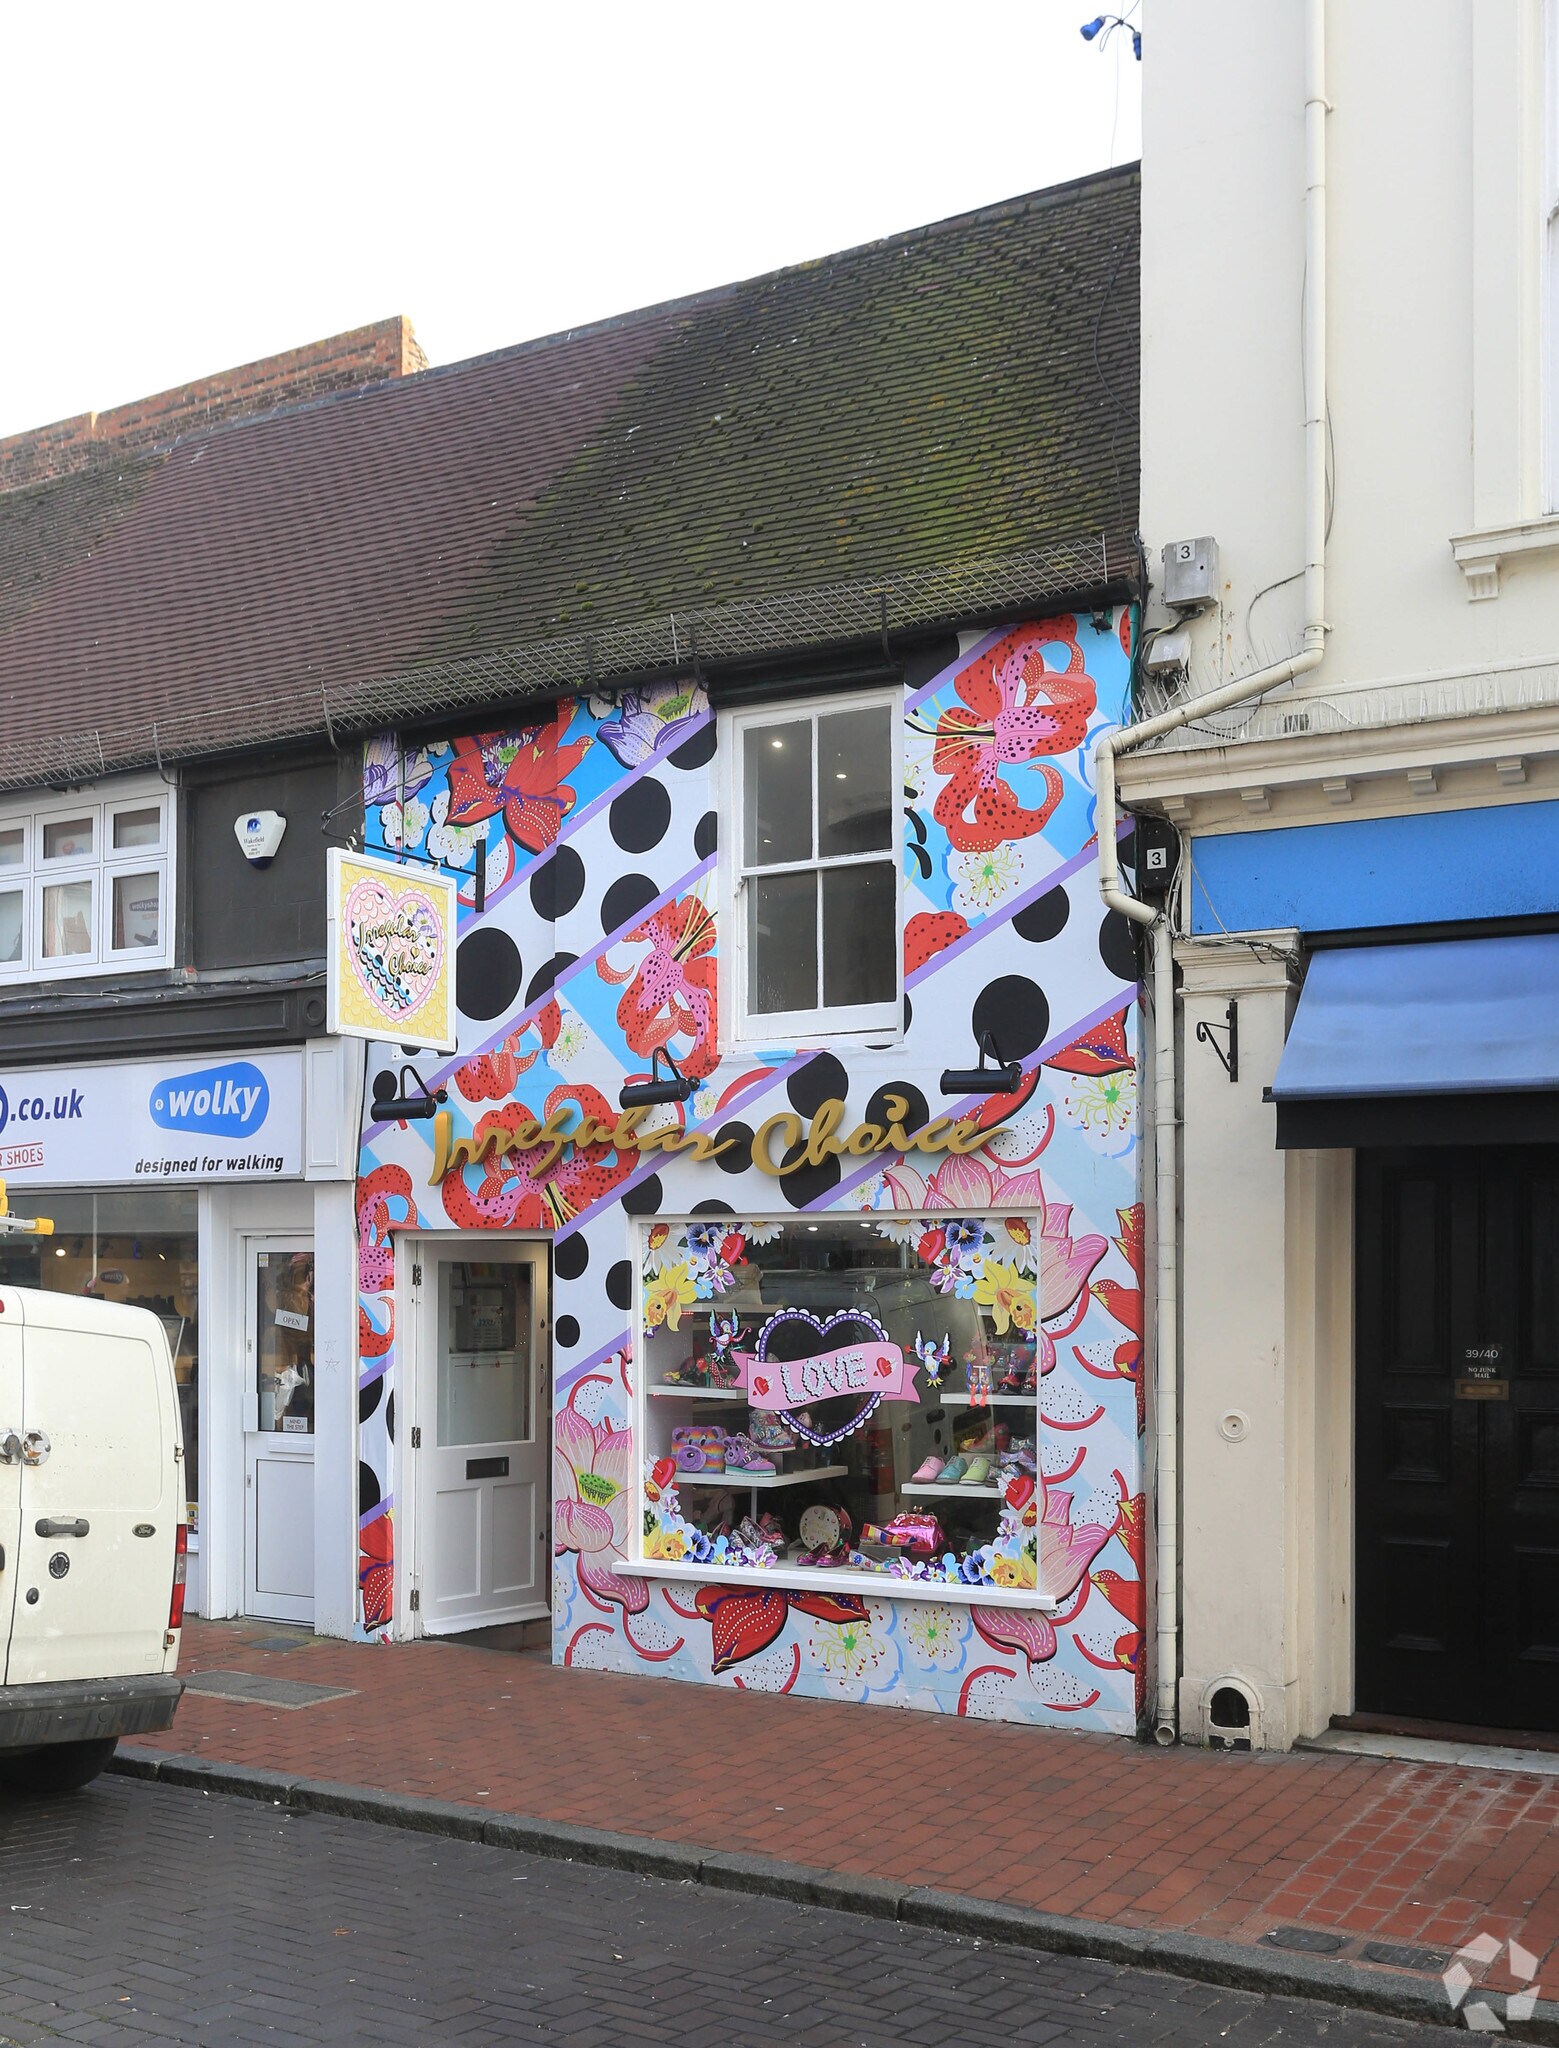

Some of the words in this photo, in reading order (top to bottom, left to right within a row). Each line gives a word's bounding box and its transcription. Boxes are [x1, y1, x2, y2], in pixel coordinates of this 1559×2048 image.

[1180, 545, 1191, 559] 3
[1152, 852, 1162, 866] 3
[357, 915, 421, 955] Irregular
[389, 951, 432, 982] Choice
[169, 1080, 262, 1122] wolky
[427, 1105, 741, 1186] Irregular
[751, 1094, 1014, 1177] Choice
[7, 1147, 44, 1166] SHOES
[135, 1157, 198, 1175] designed
[201, 1156, 223, 1171] for
[226, 1154, 284, 1172] walking
[282, 1316, 301, 1326] OPEN
[1465, 1350, 1499, 1358] 39/40
[780, 1351, 868, 1403] LOVE
